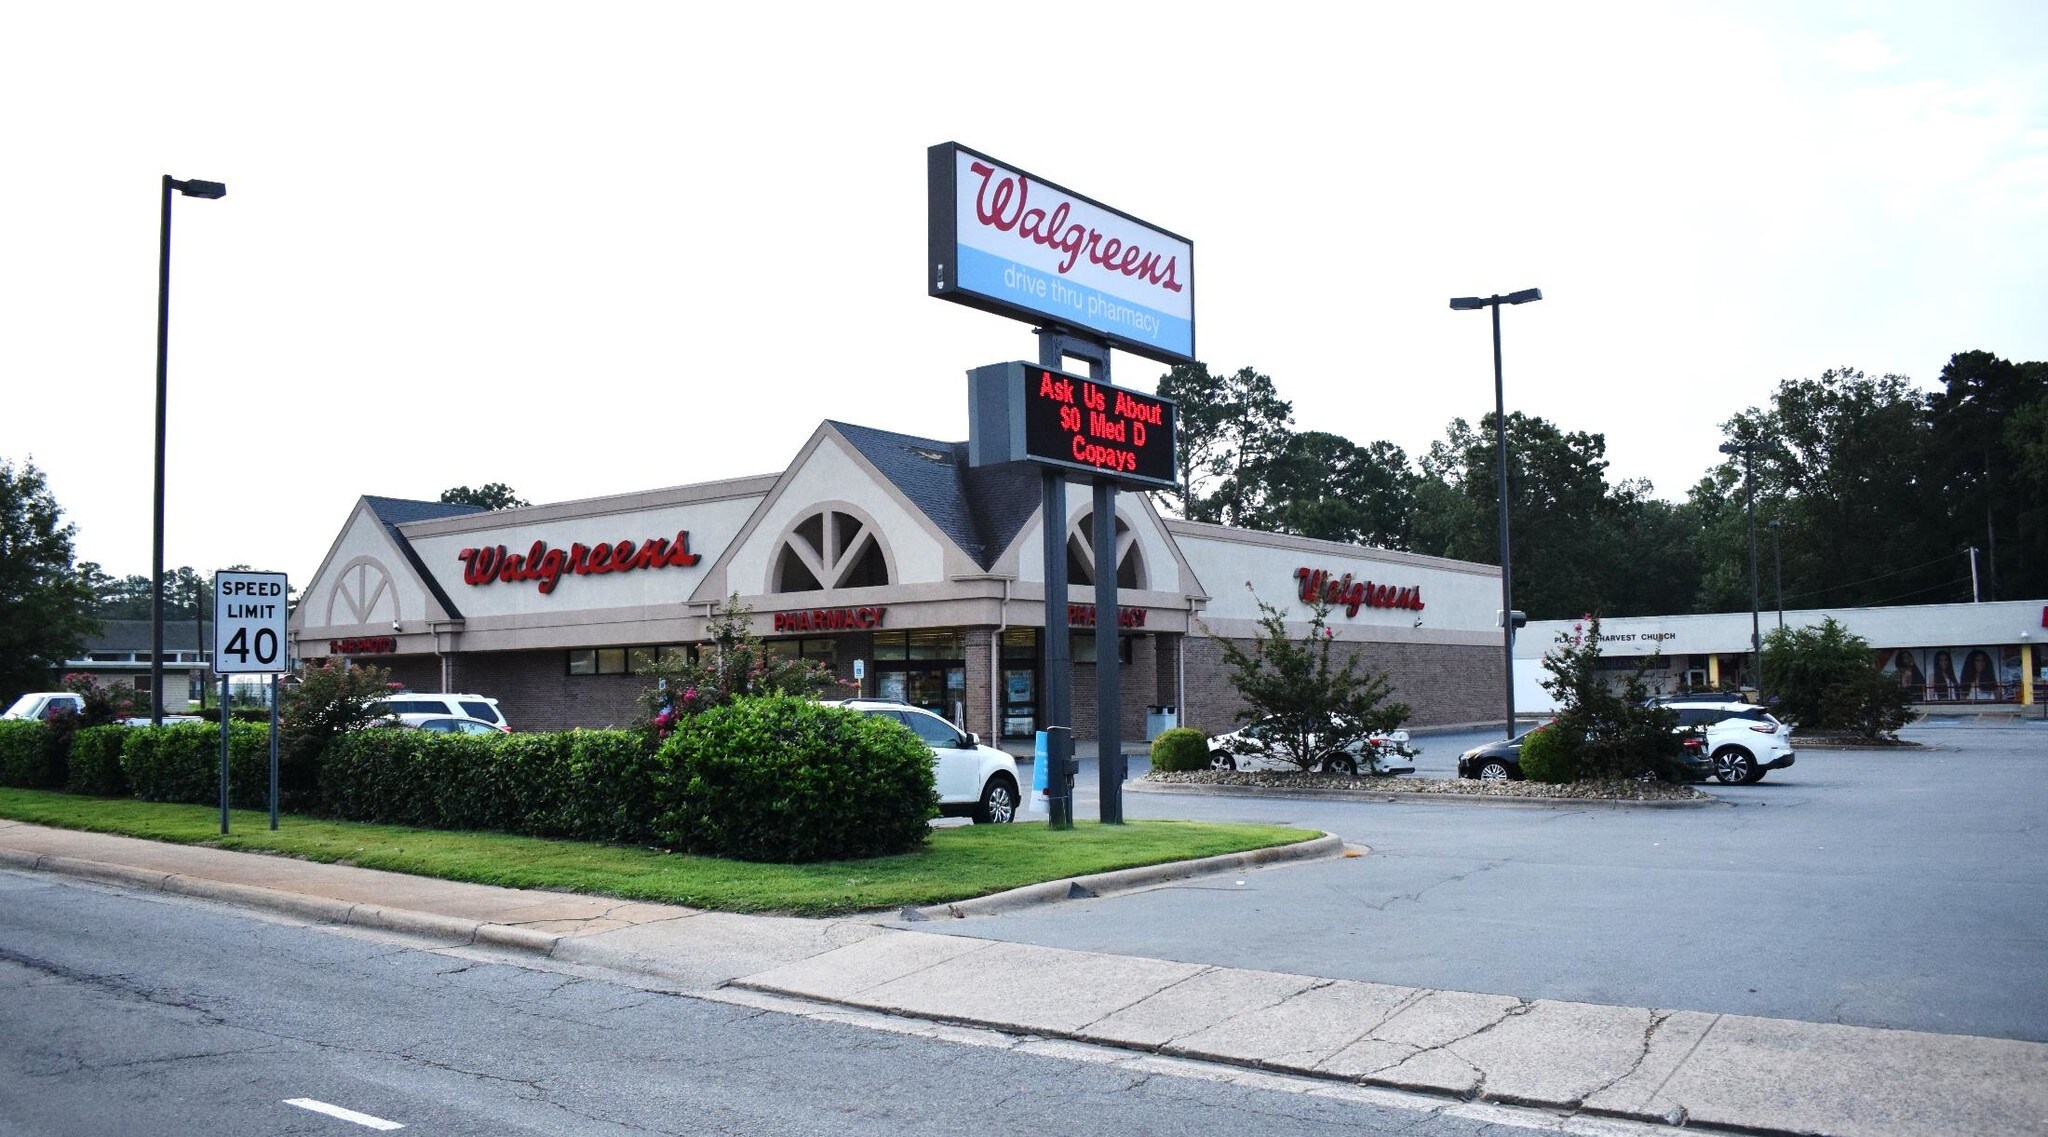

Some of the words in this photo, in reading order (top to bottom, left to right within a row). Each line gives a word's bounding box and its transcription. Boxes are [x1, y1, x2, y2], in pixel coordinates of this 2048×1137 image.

[970, 161, 1183, 293] Walgreens
[1004, 264, 1047, 298] drive
[1051, 279, 1083, 310] thru
[1088, 293, 1160, 339] pharmacy
[1040, 371, 1075, 404] Ask
[1083, 382, 1106, 411] Us
[1114, 391, 1162, 426] About
[1060, 404, 1081, 432] $0
[1090, 410, 1126, 443] Med
[1133, 421, 1146, 447] D
[1072, 434, 1137, 472] Copays
[458, 529, 702, 594] Walgreens
[222, 581, 281, 597] SPEED
[1293, 567, 1426, 618] Walgreens
[227, 603, 275, 619] LIMIT
[774, 606, 887, 632] PHARMACY
[1067, 604, 1148, 628] PHAACY
[224, 627, 278, 664] 40
[1600, 633, 1637, 642] HARVEST
